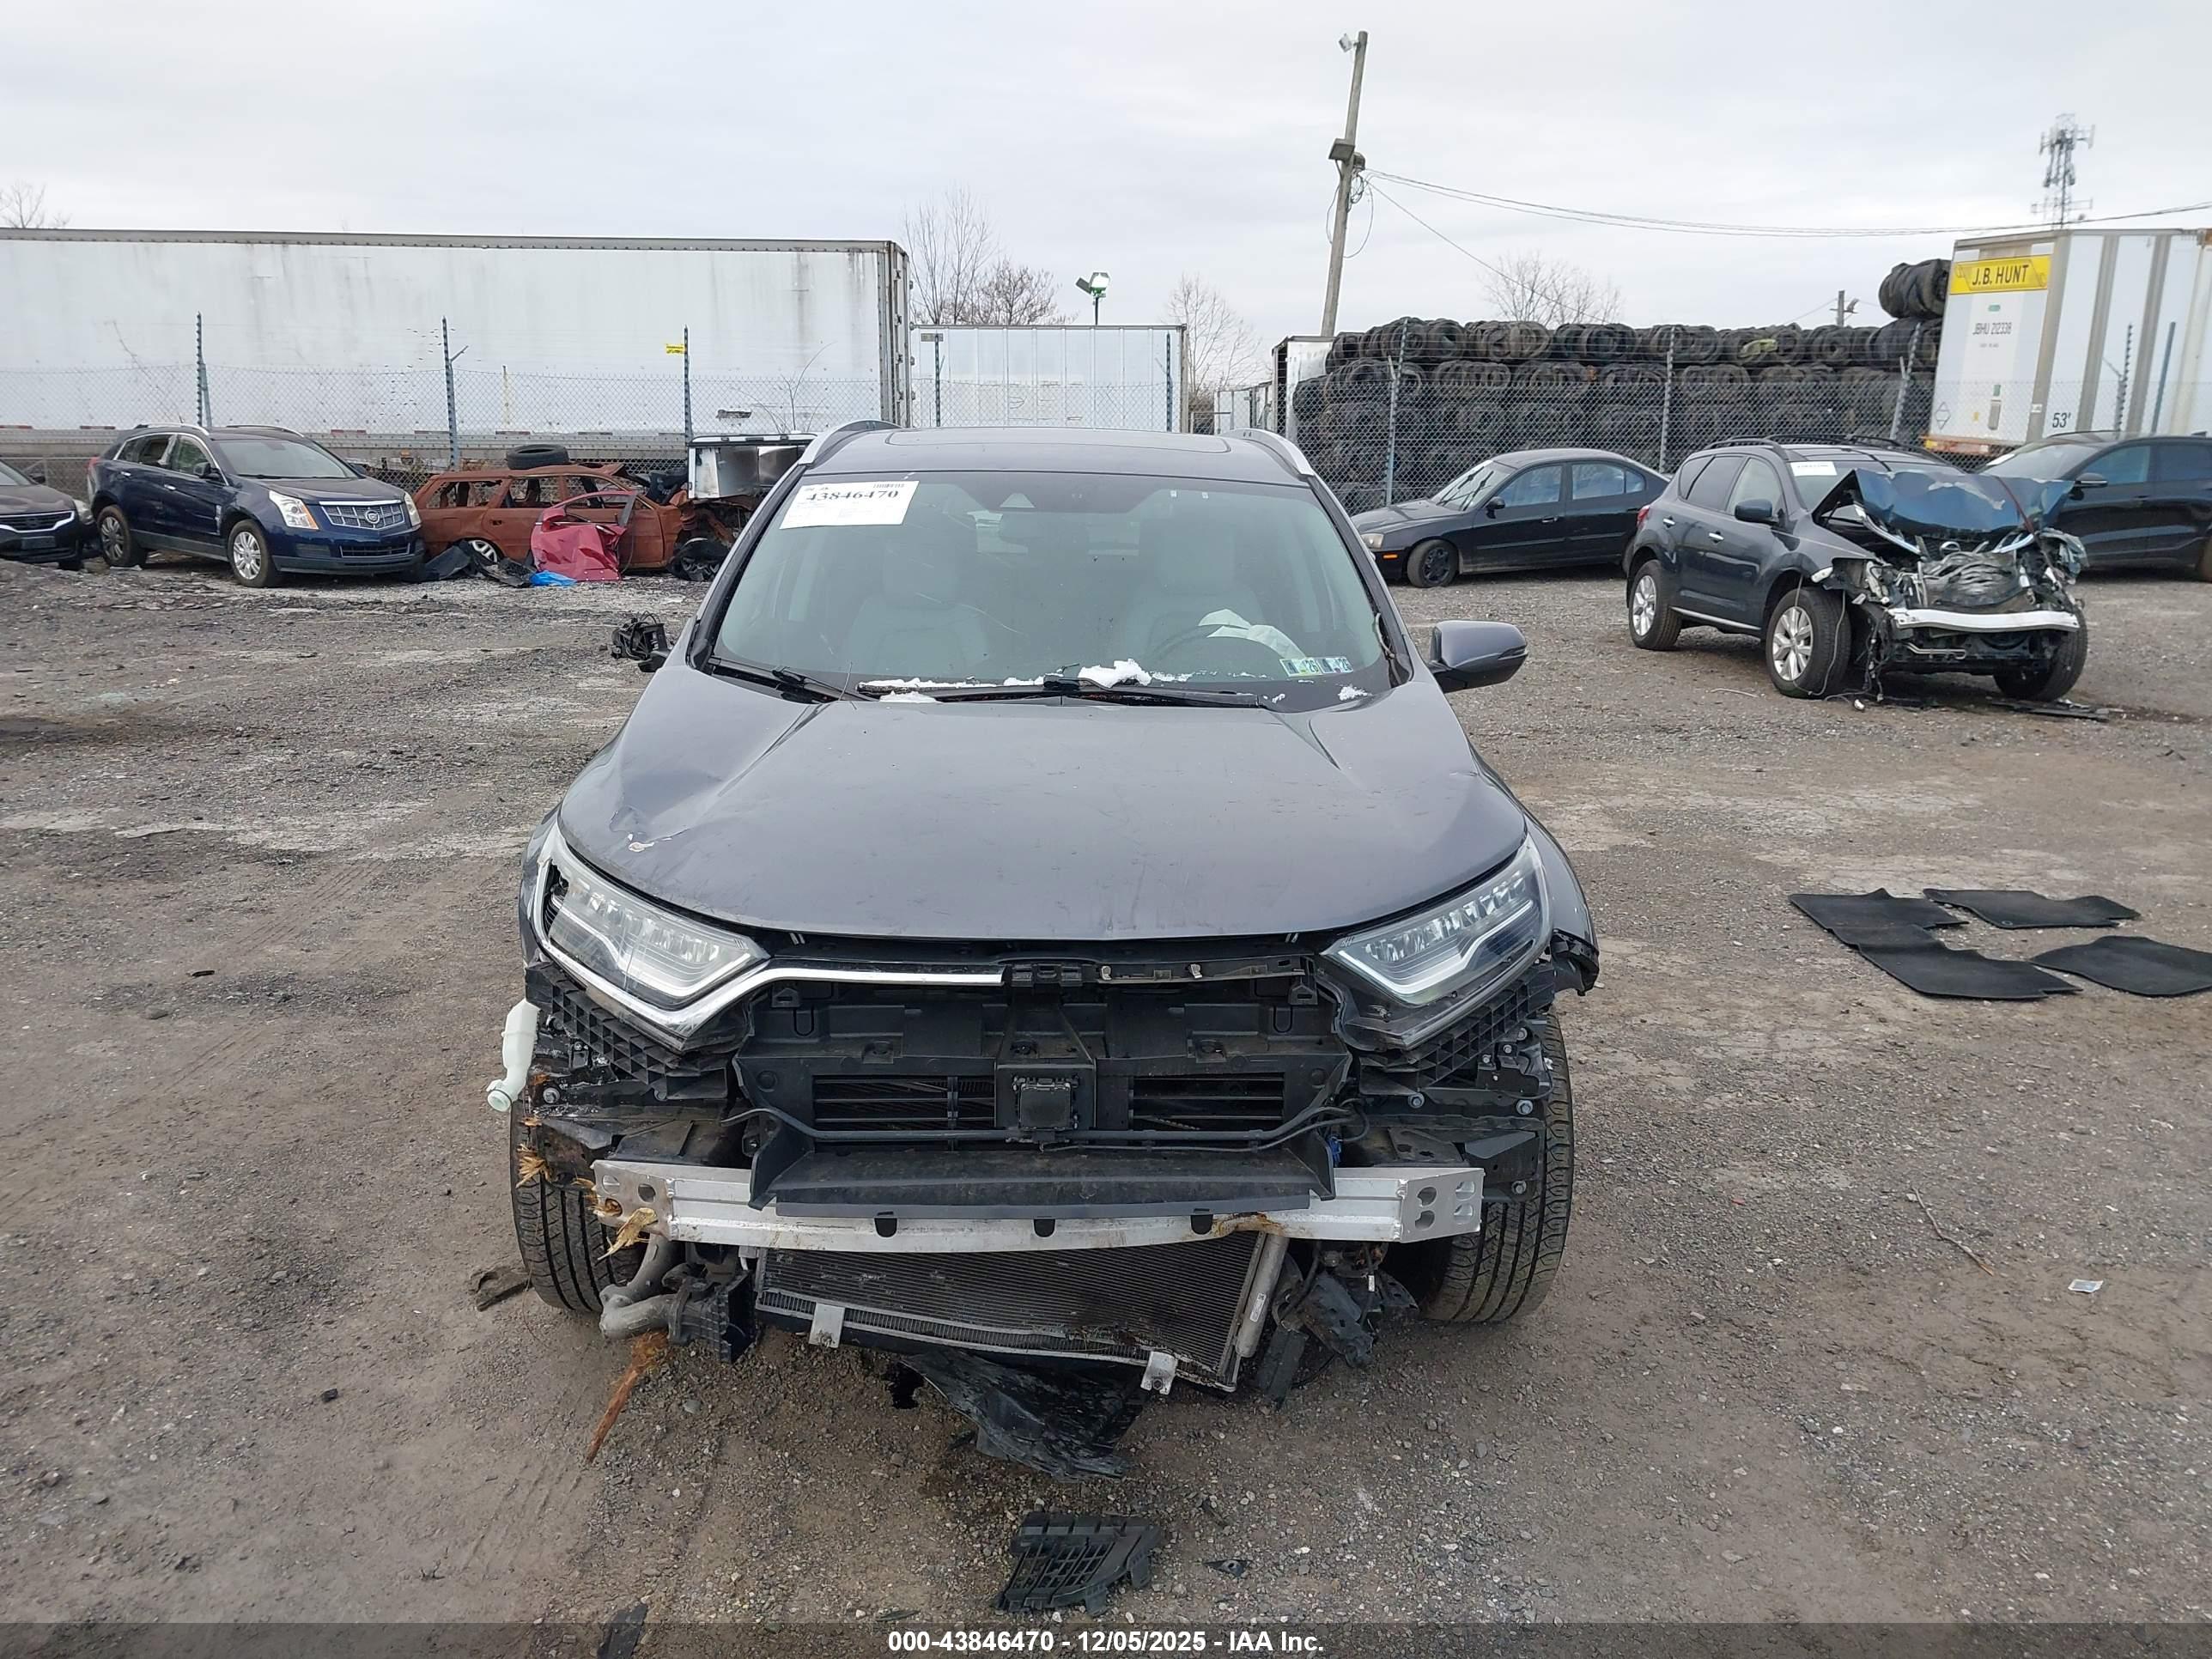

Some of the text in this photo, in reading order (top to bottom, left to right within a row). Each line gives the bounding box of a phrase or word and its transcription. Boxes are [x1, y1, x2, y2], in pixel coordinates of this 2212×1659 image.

[1972, 264, 2029, 285] J.B. HUNT
[805, 489, 899, 501] 43846470
